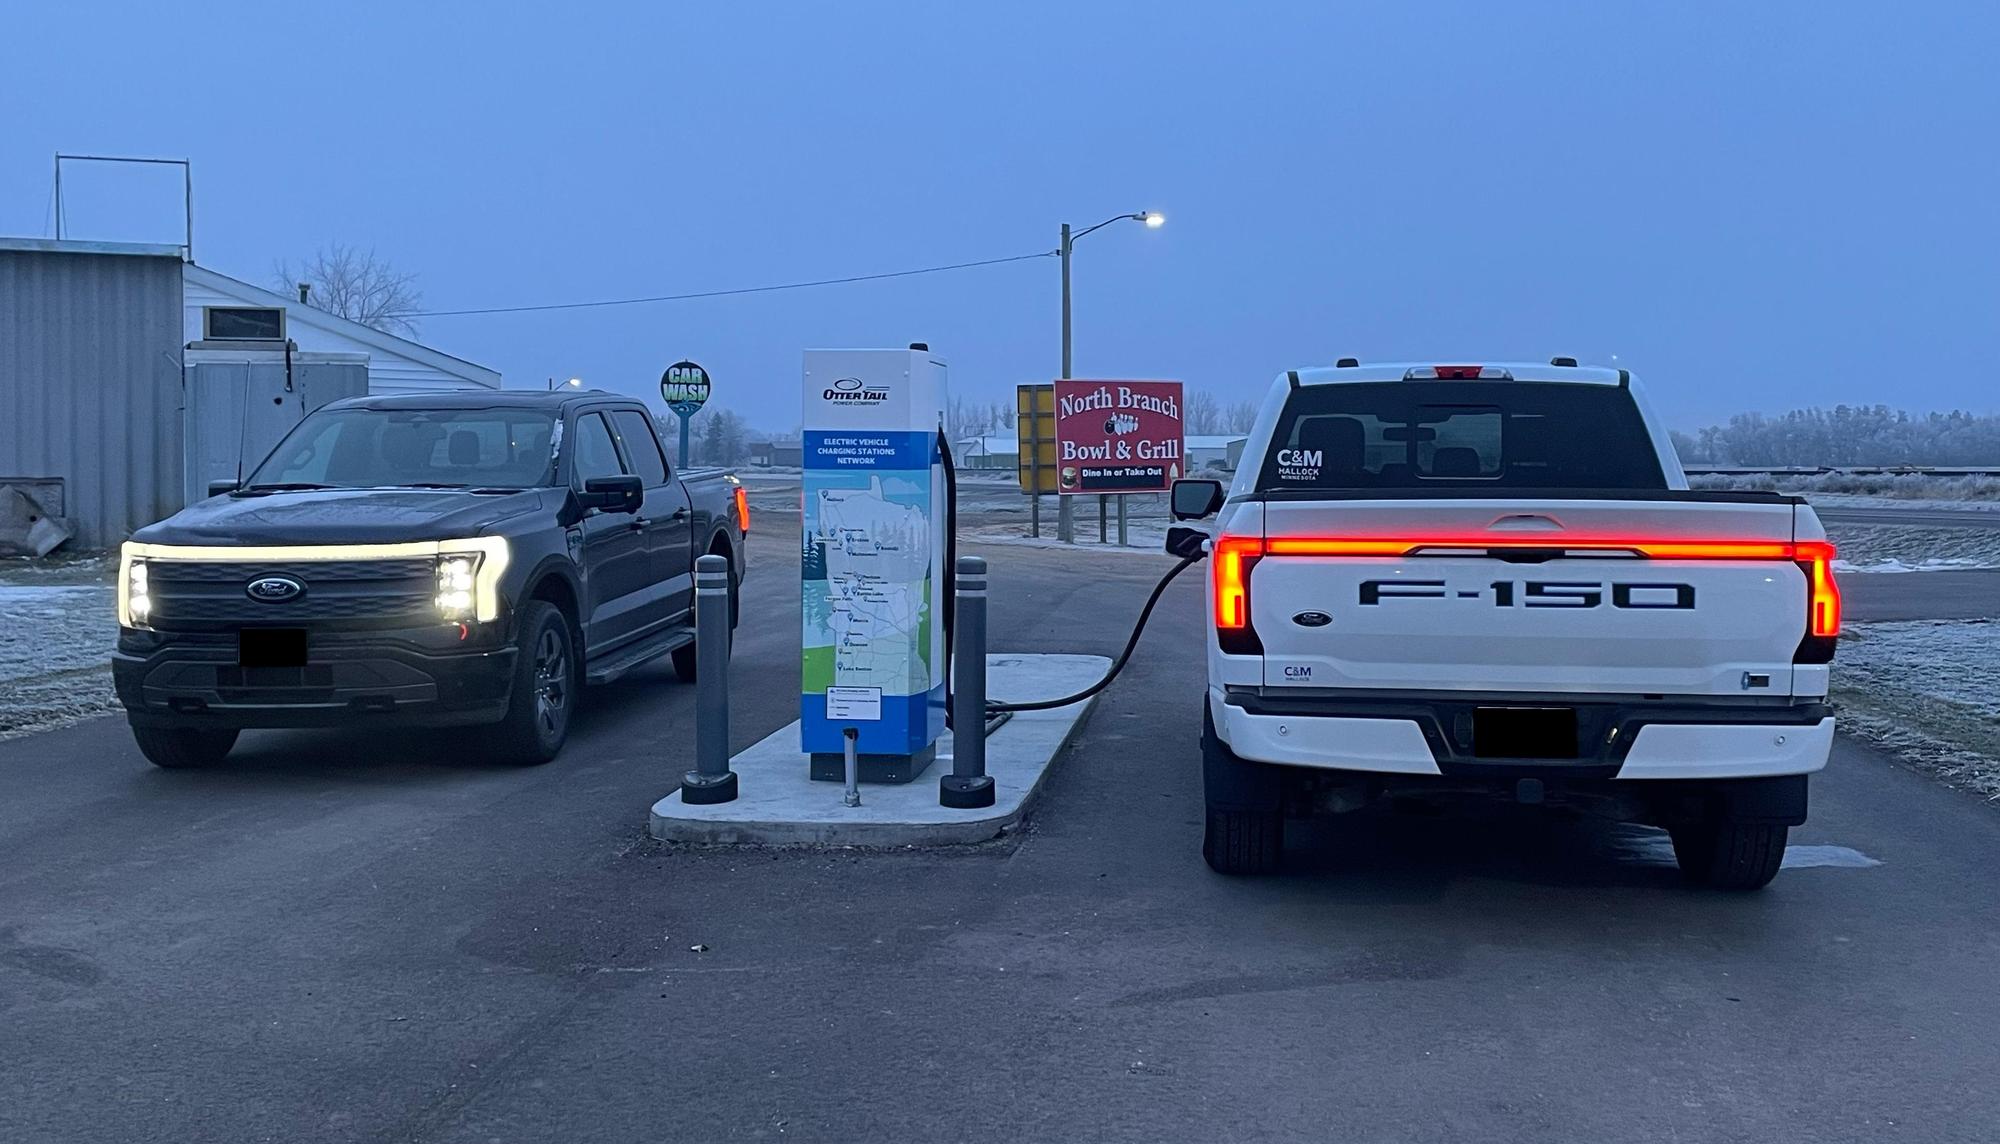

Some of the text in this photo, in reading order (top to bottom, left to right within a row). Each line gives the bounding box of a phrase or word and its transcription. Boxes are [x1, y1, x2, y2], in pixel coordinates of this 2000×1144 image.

[668, 367, 703, 384] CAR
[663, 383, 708, 401] WASH
[1060, 386, 1179, 420] North Branch
[823, 438, 889, 446] ELECTRIC VEHICLE
[817, 447, 896, 456] CHARGING STATIONS
[1062, 439, 1179, 460] Bowl & Grill
[837, 457, 876, 465] NETWORK
[1277, 449, 1323, 467] C&M
[1082, 468, 1101, 477] Dine
[1103, 468, 1112, 477] In
[1124, 468, 1146, 476] Take
[1147, 468, 1163, 476] Out
[1278, 467, 1320, 476] HALLOCK
[259, 583, 287, 595] Ford
[1358, 579, 1696, 610] F-150
